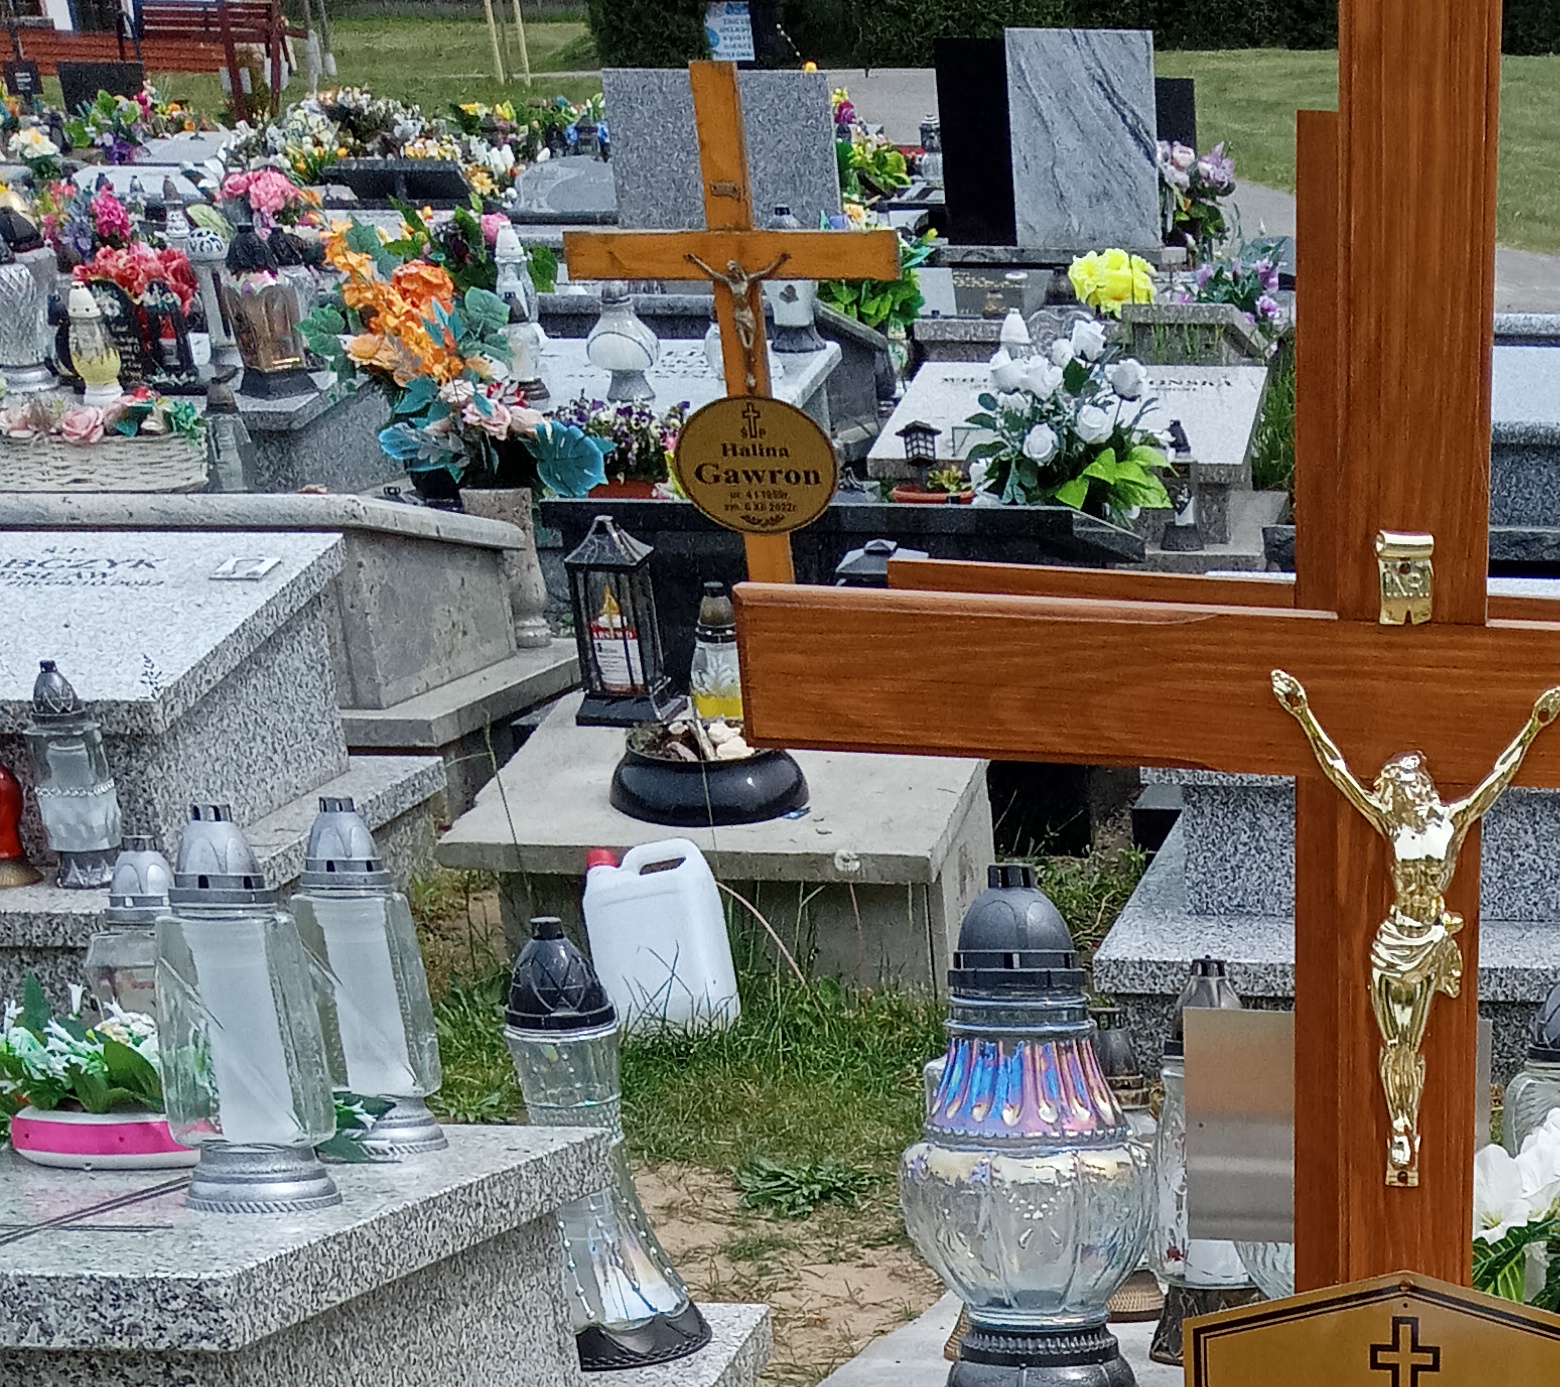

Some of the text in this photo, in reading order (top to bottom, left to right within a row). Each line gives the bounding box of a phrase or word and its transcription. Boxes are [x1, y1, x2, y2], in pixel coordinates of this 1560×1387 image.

[721, 443, 790, 458] Halina
[695, 463, 821, 486] Gawron
[0, 558, 167, 569] BCZYK
